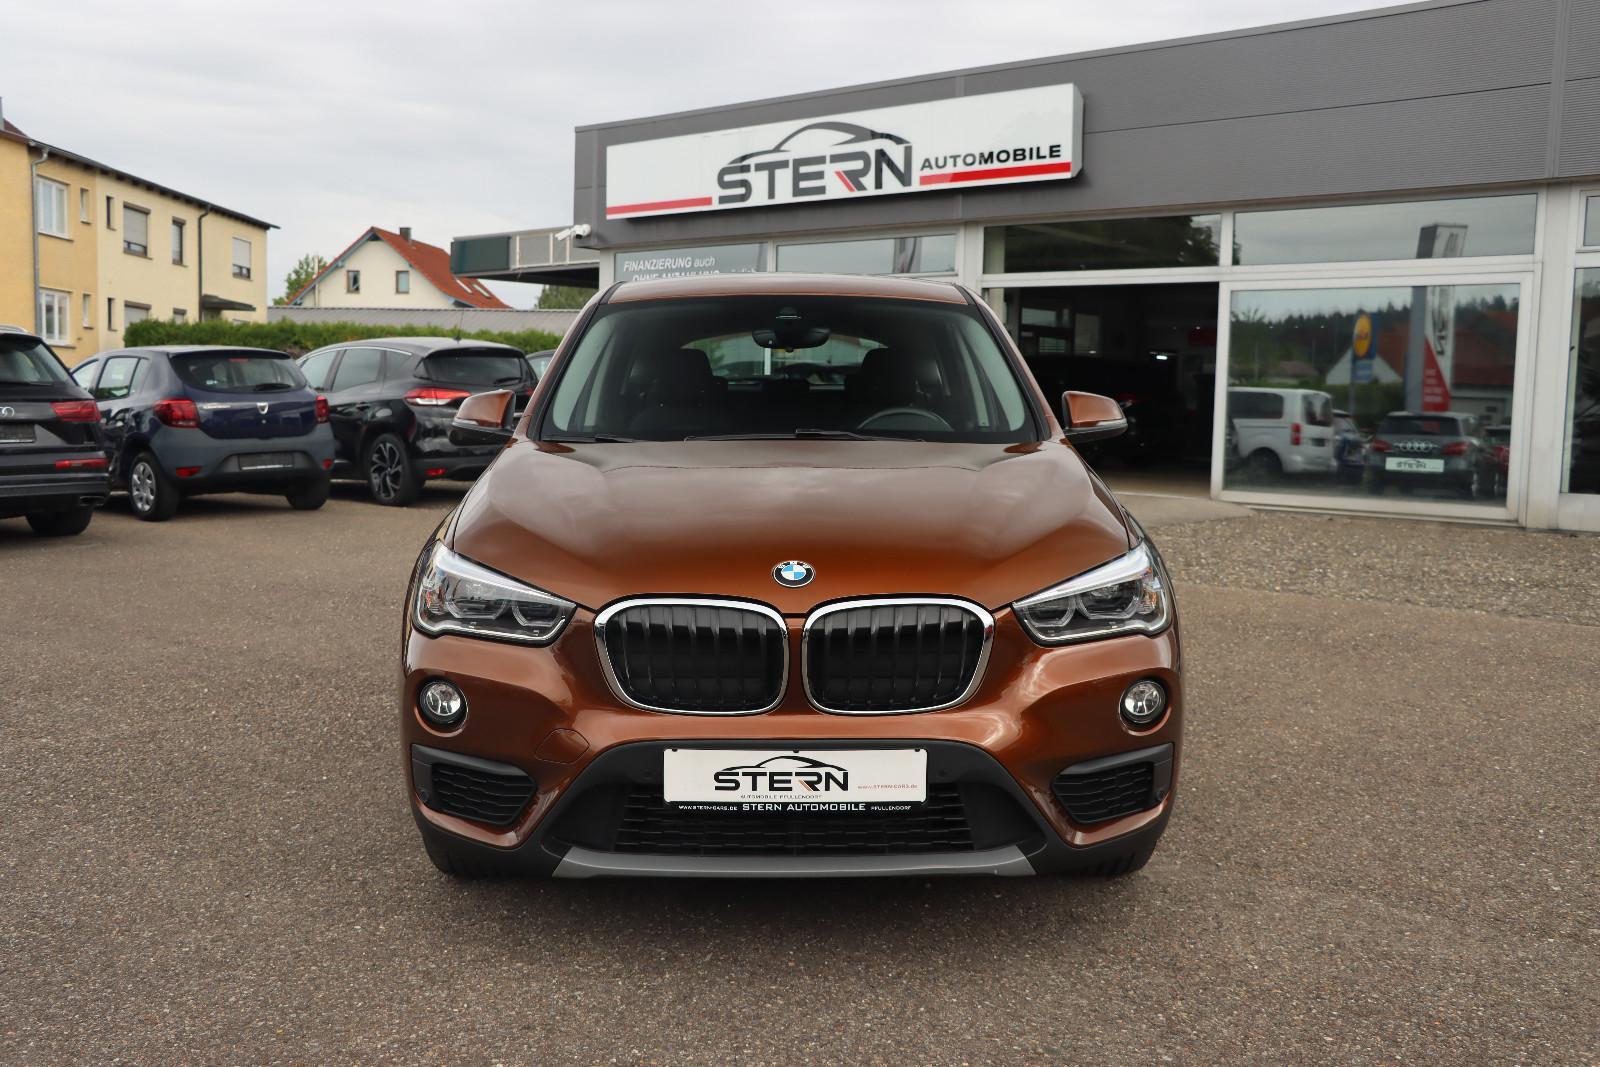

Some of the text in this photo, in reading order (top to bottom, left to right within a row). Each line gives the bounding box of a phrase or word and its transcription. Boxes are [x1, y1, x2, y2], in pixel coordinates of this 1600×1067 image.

[920, 144, 1062, 171] AUTOMOBILE
[716, 144, 912, 206] STERN
[623, 255, 716, 273] FINANZIERUNG auch
[713, 771, 849, 792] STERN
[742, 803, 782, 811] STERN
[787, 803, 866, 811] AUTOMOBILE
